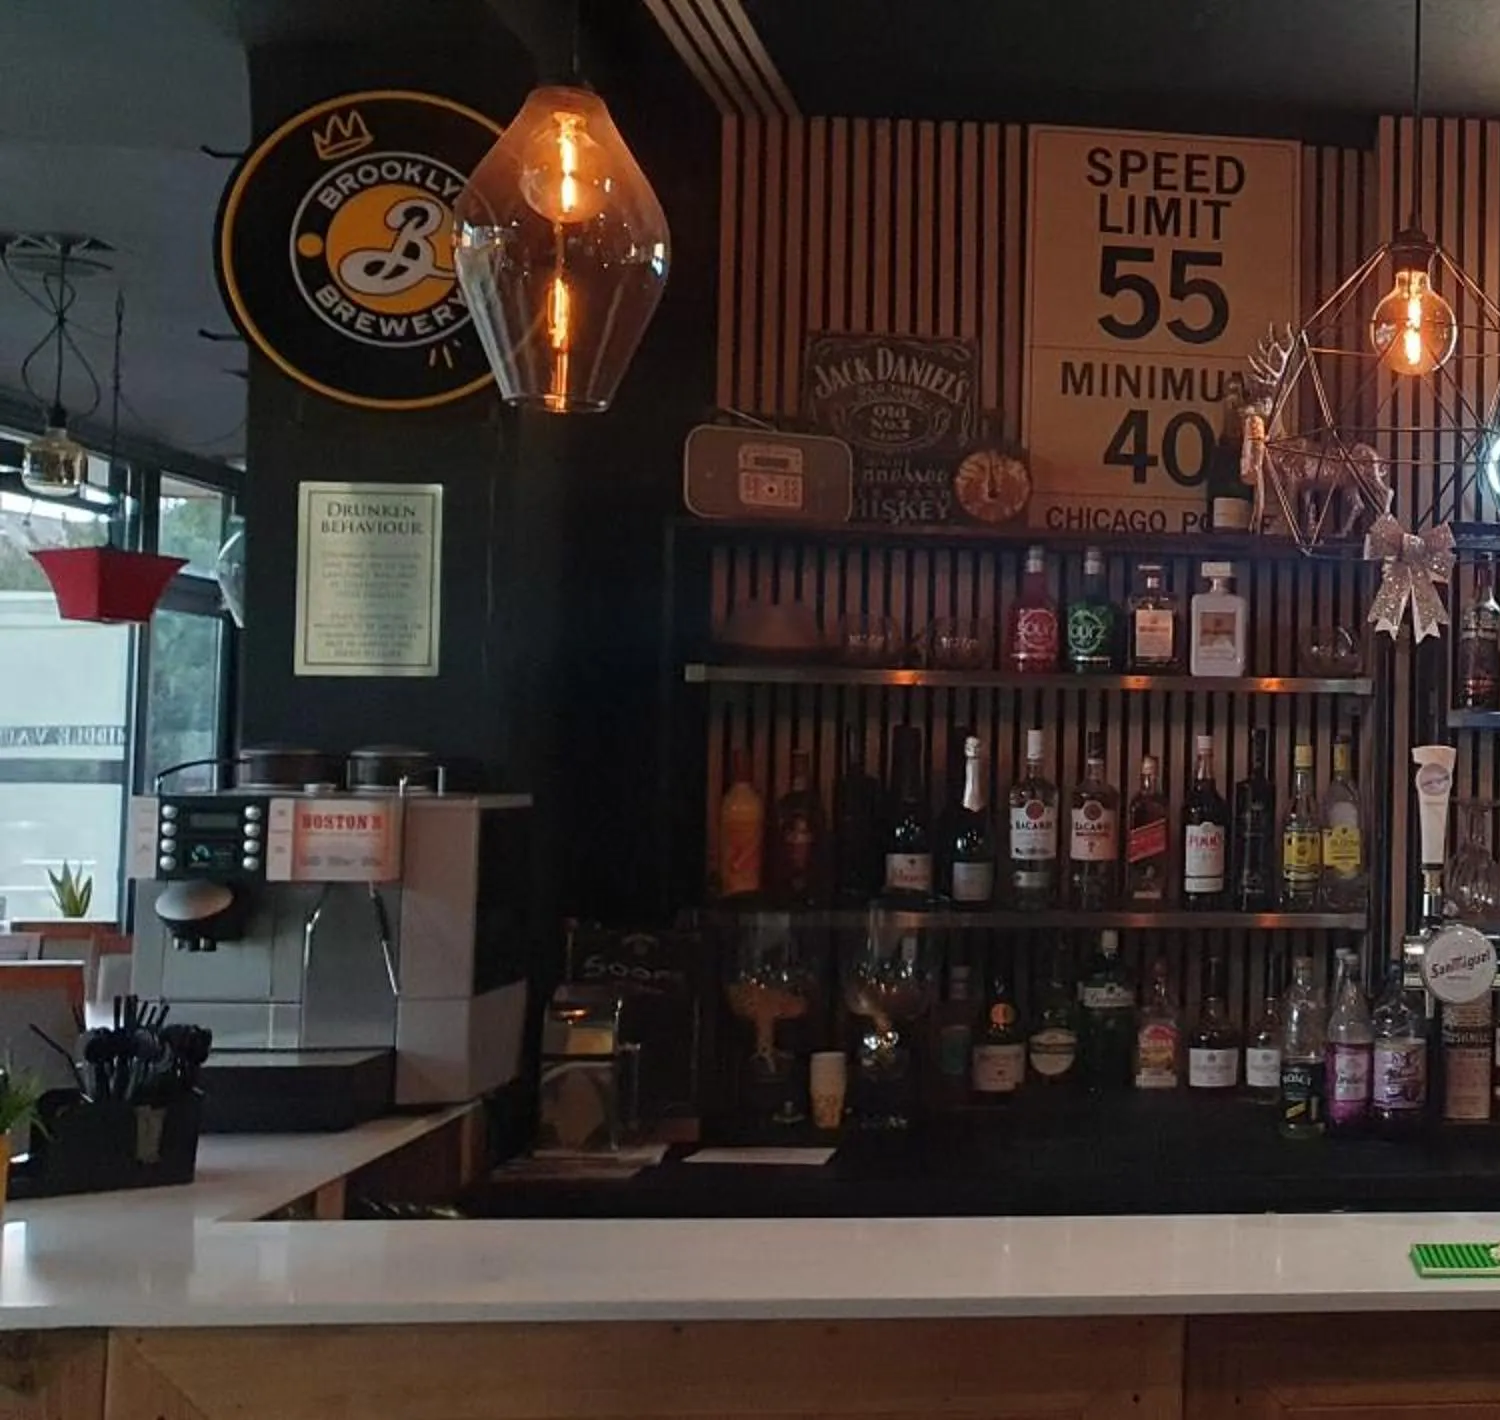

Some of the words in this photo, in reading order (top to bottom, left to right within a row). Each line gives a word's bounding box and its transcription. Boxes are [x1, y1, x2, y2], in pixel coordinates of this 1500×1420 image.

[317, 160, 463, 210] BROOKLY
[1086, 147, 1246, 195] SPEED
[1099, 194, 1232, 240] LIMIT
[315, 284, 469, 336] BREWERY
[1098, 246, 1230, 344] 55
[813, 356, 873, 400] JACK
[876, 347, 971, 405] DANIEL'S
[1103, 410, 1217, 487] 40
[321, 521, 425, 535] BEHAVIOUR
[328, 502, 416, 518] DRUNKEN
[853, 498, 953, 521] HISKEY
[1046, 506, 1167, 534] CHICAGO
